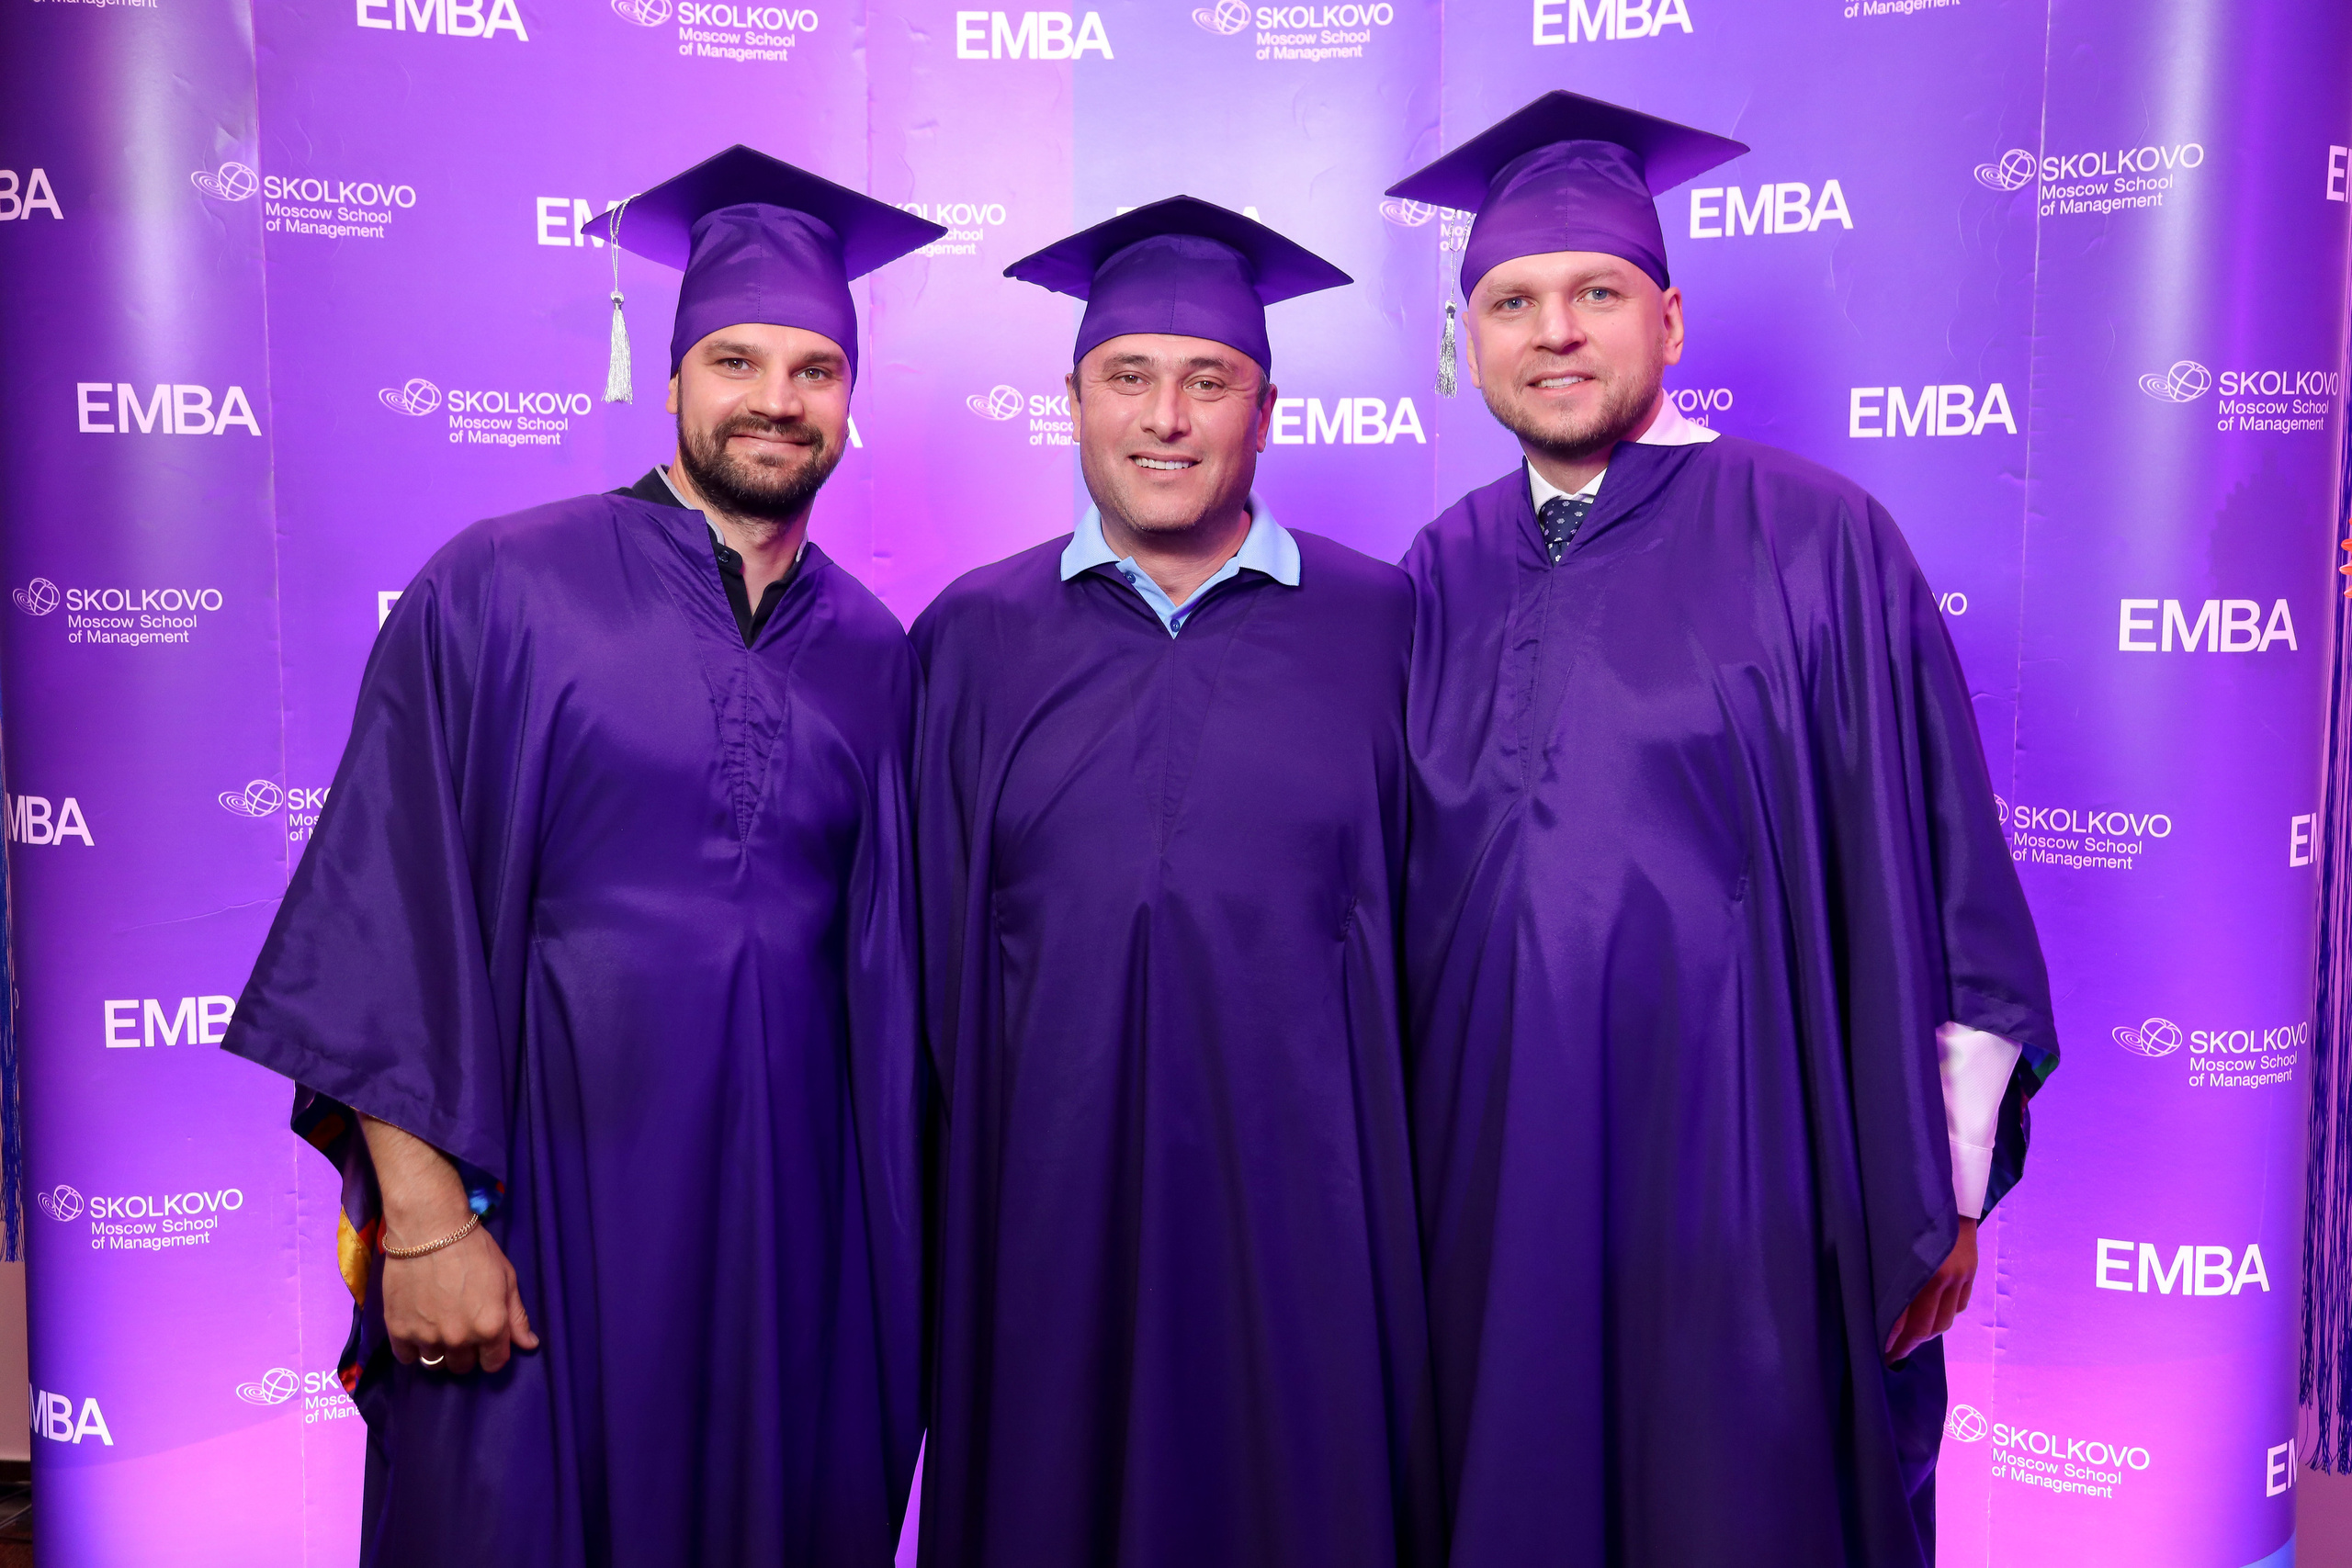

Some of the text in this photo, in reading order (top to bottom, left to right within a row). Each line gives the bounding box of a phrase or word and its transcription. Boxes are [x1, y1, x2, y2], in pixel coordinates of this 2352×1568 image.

[356, 0, 529, 41] EMBA
[678, 2, 819, 32] SKOLKOVO
[1256, 3, 1394, 29] SKOLKOVO
[1844, 3, 1860, 18] of
[1532, 0, 1694, 46] EMBA
[679, 27, 796, 47] Moscow School
[956, 11, 1114, 60] EMBA
[1257, 28, 1370, 45] Moscow School
[679, 42, 787, 62] of Management
[1256, 44, 1363, 62] of Management
[2041, 143, 2204, 182] SKOLKOVO
[264, 175, 416, 208] SKOLKOVO
[2041, 174, 2173, 199] Moscow School
[266, 201, 391, 223] Moscow School
[1690, 179, 1854, 239] EMBA
[2041, 192, 2163, 216] of Management
[266, 218, 384, 239] of Management
[2219, 371, 2339, 396] SKOLKOVO
[77, 382, 262, 436] EMBA
[447, 389, 592, 415] SKOLKOVO
[1849, 383, 2018, 438] EMBA
[2219, 399, 2329, 414] Moscow School
[449, 415, 568, 431] Moscow School
[1272, 397, 1427, 445] EMBA
[2218, 416, 2324, 434] of Management
[449, 430, 561, 447] of Management
[1029, 433, 1044, 446] of
[66, 589, 222, 611] SKOLKOVO
[68, 615, 197, 628] Moscow School
[2119, 599, 2298, 652] EMBA
[68, 629, 189, 647] of Management
[2014, 806, 2171, 838] SKOLKOVO
[289, 828, 303, 841] of
[2014, 831, 2142, 854] Moscow School
[2013, 848, 2132, 870] of Management
[2189, 1021, 2308, 1054] SKOLKOVO
[2190, 1051, 2297, 1071] Moscow School
[2188, 1068, 2292, 1089] of Management
[90, 1189, 243, 1219] SKOLKOVO
[92, 1215, 218, 1235] Moscow School
[92, 1231, 209, 1251] of Management
[2096, 1238, 2270, 1296] EMBA
[305, 1410, 319, 1424] of
[1992, 1423, 2150, 1470] SKOLKOVO
[1992, 1448, 2121, 1484] Moscow School
[1991, 1465, 2112, 1498] of Management
